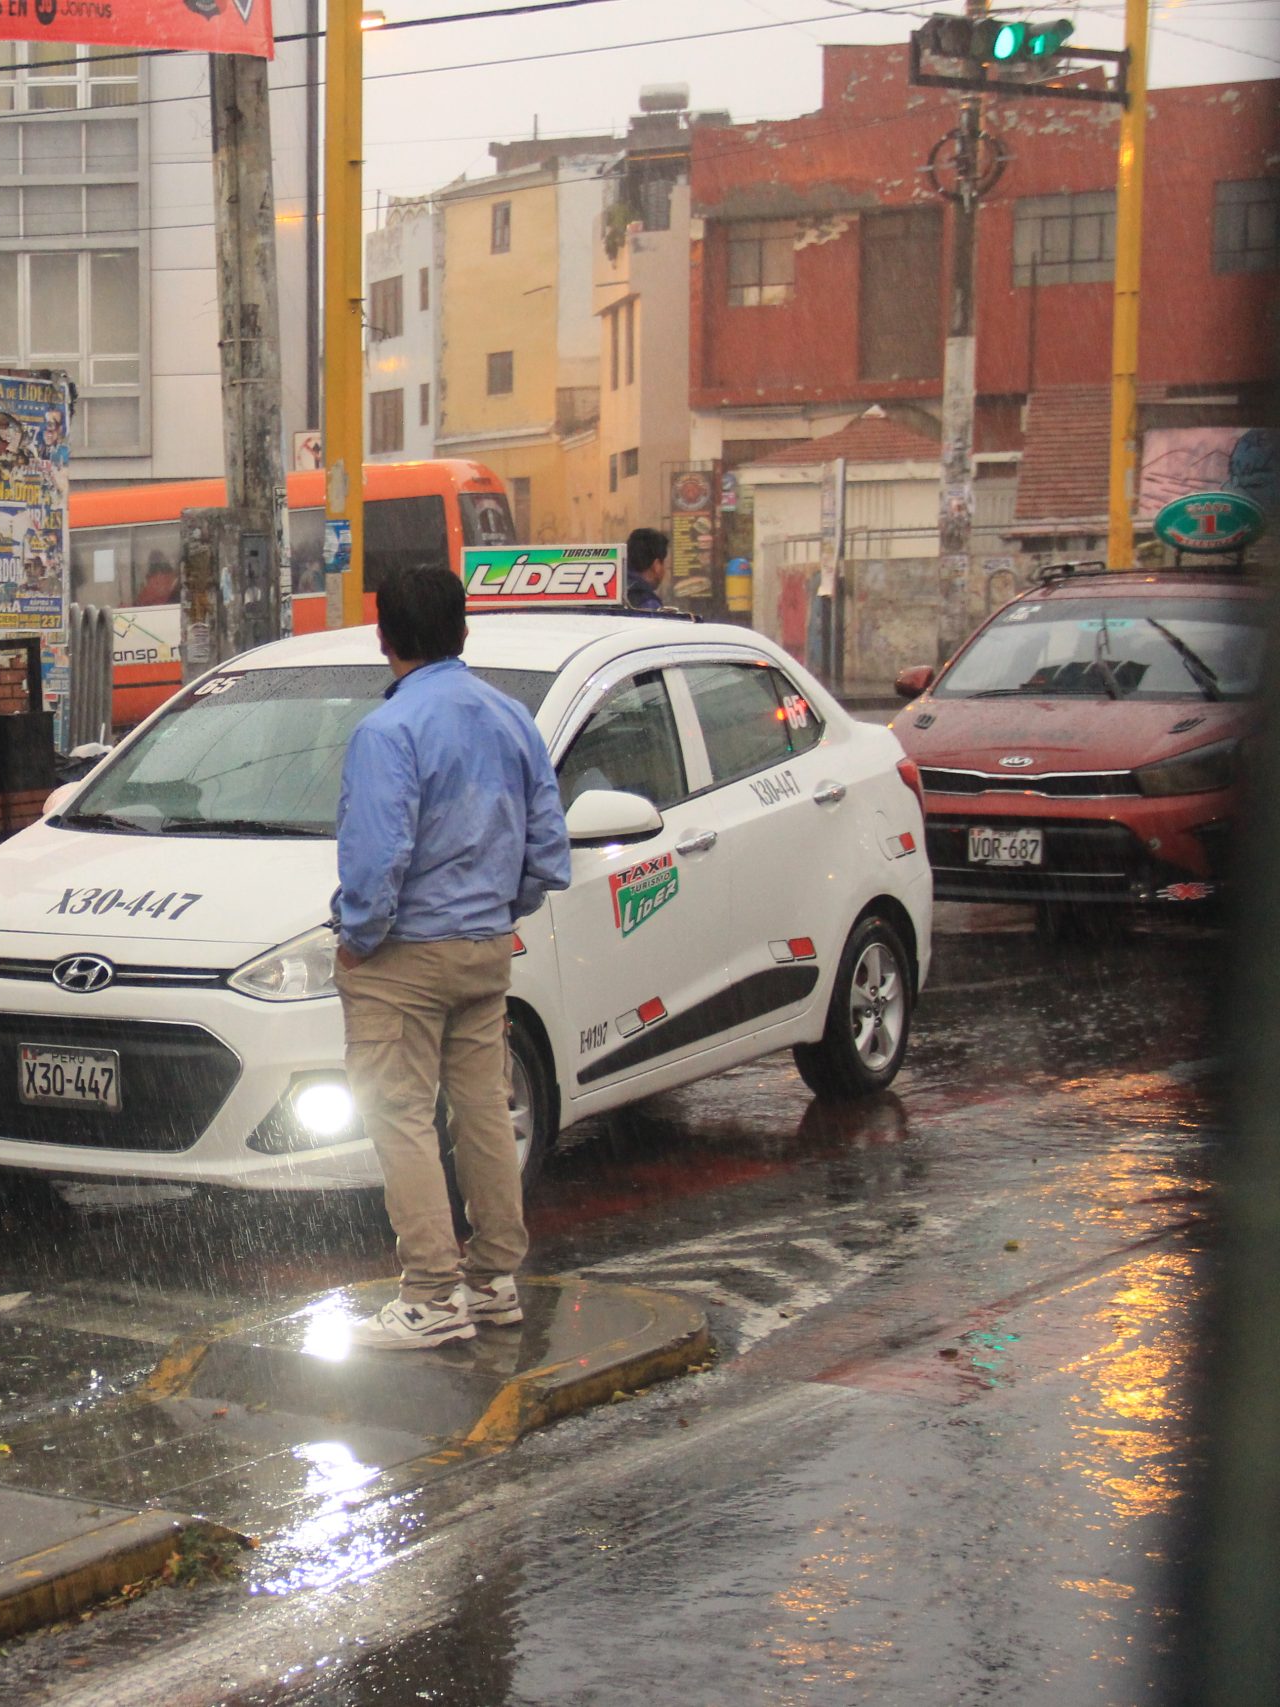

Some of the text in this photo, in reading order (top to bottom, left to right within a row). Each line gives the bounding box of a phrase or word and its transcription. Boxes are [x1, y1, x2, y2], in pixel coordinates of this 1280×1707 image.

[8, 0, 28, 17] EN
[562, 548, 610, 558] TURISMO
[466, 553, 617, 597] LÍDER
[41, 615, 61, 629] 237
[193, 676, 245, 696] 65
[782, 694, 808, 730] 65
[749, 770, 801, 808] X30-447
[617, 856, 668, 884] TAXI
[630, 872, 670, 894] TURISMO
[46, 888, 204, 921] X30-447
[51, 1053, 87, 1065] PERU
[24, 1061, 114, 1101] X30-447
